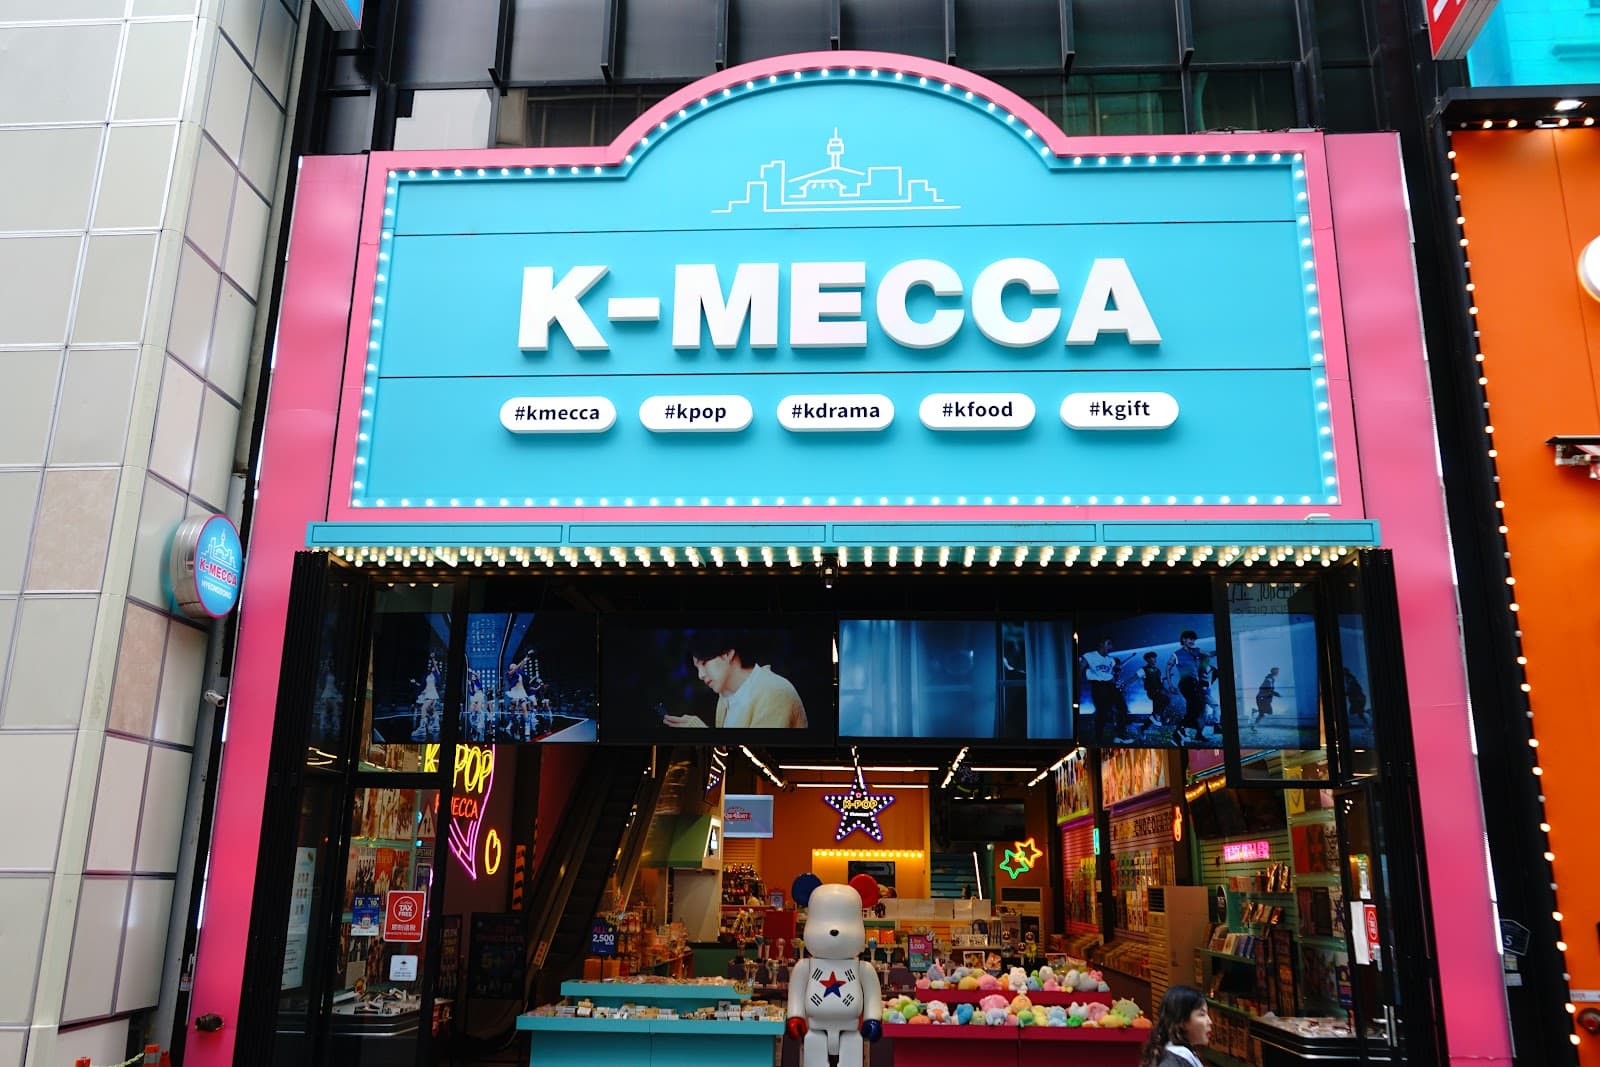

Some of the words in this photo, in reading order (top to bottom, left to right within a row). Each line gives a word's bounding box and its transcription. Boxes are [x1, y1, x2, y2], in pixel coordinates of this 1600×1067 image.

[518, 257, 1162, 351] K-MECCA
[514, 404, 601, 421] #kmecca
[664, 403, 727, 422] #kpop
[791, 402, 881, 419] #kdrama
[942, 400, 1014, 418] #kfood
[1089, 400, 1151, 421] #kgift
[199, 557, 237, 586] K-MECCA
[843, 799, 878, 810] K-POP
[398, 904, 413, 912] TAX
[592, 934, 615, 943] 2,500
